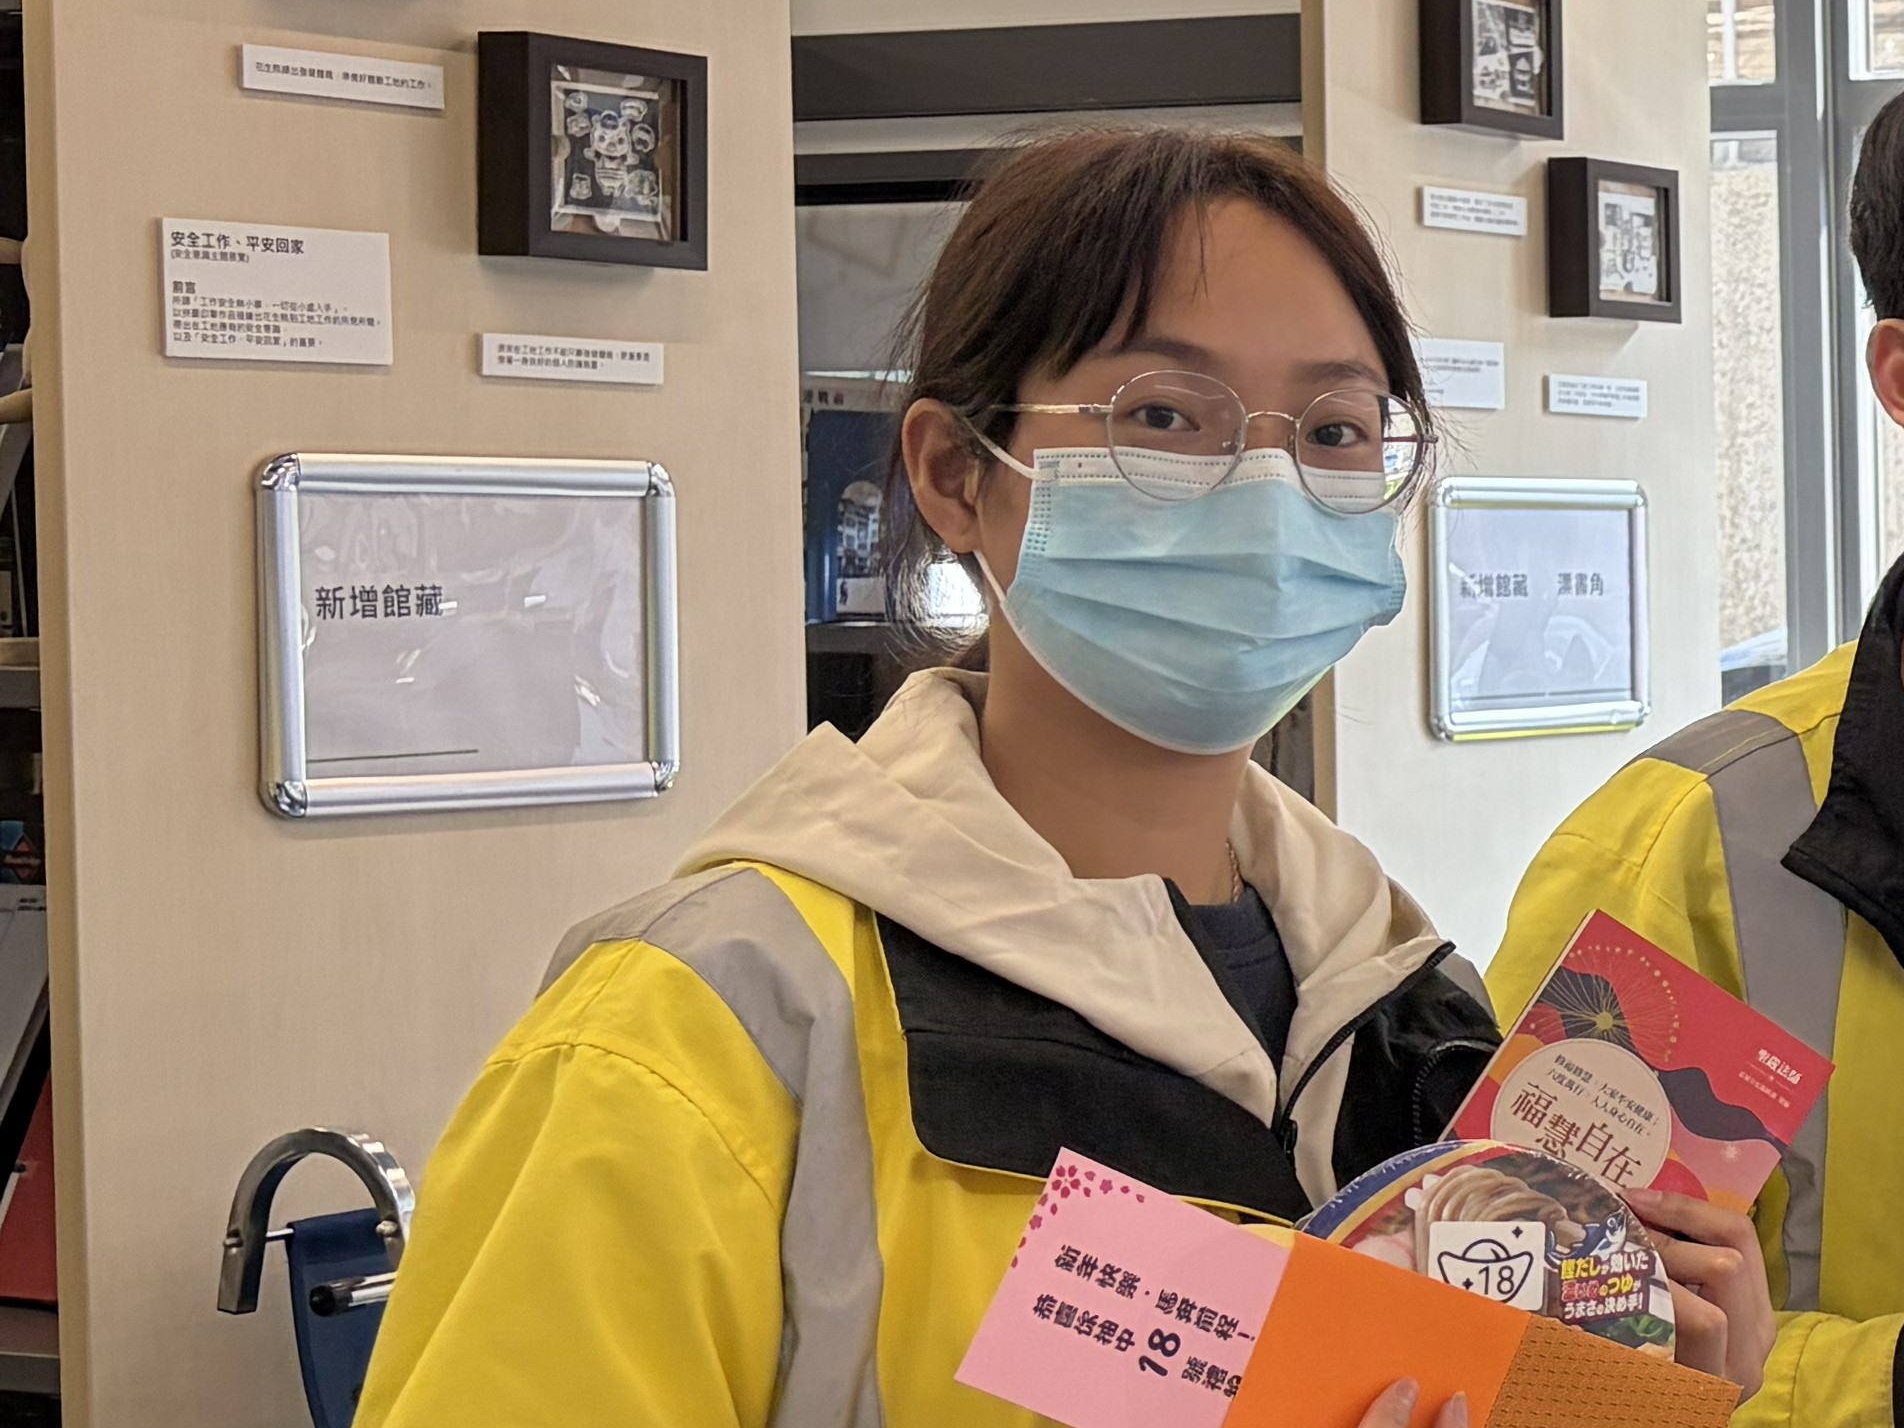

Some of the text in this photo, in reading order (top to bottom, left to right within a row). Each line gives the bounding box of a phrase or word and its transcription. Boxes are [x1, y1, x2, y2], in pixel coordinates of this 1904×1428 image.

[171, 231, 305, 255] 安全工作、平安回家
[315, 583, 445, 621] 新增館藏
[1511, 1082, 1642, 1191] 福慧自在
[1478, 1265, 1515, 1295] 18
[1138, 1328, 1182, 1377] 18
